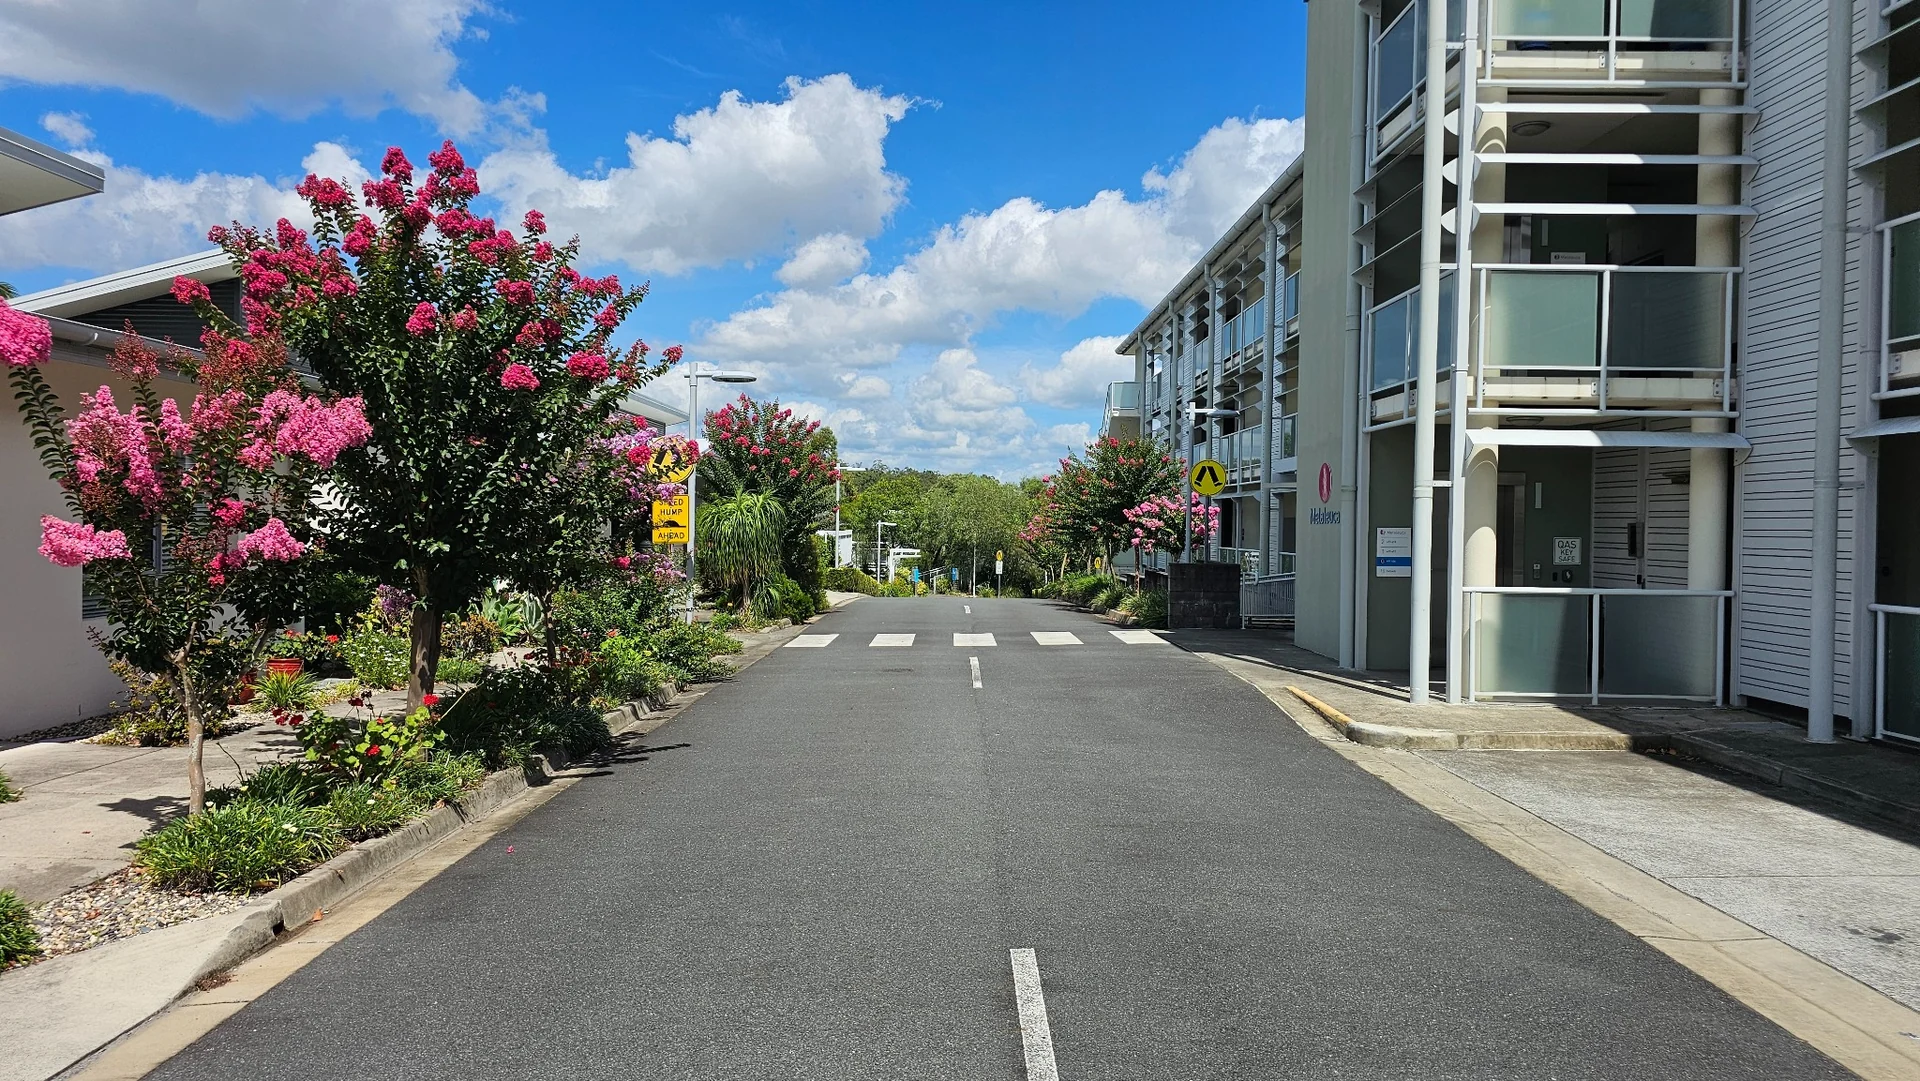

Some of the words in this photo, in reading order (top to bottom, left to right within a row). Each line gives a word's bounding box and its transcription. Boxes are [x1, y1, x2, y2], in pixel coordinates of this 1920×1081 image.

[659, 498, 684, 506] SED
[1310, 507, 1341, 524] Melaleuca
[657, 532, 685, 540] AHEAD
[1557, 540, 1577, 549] QAS
